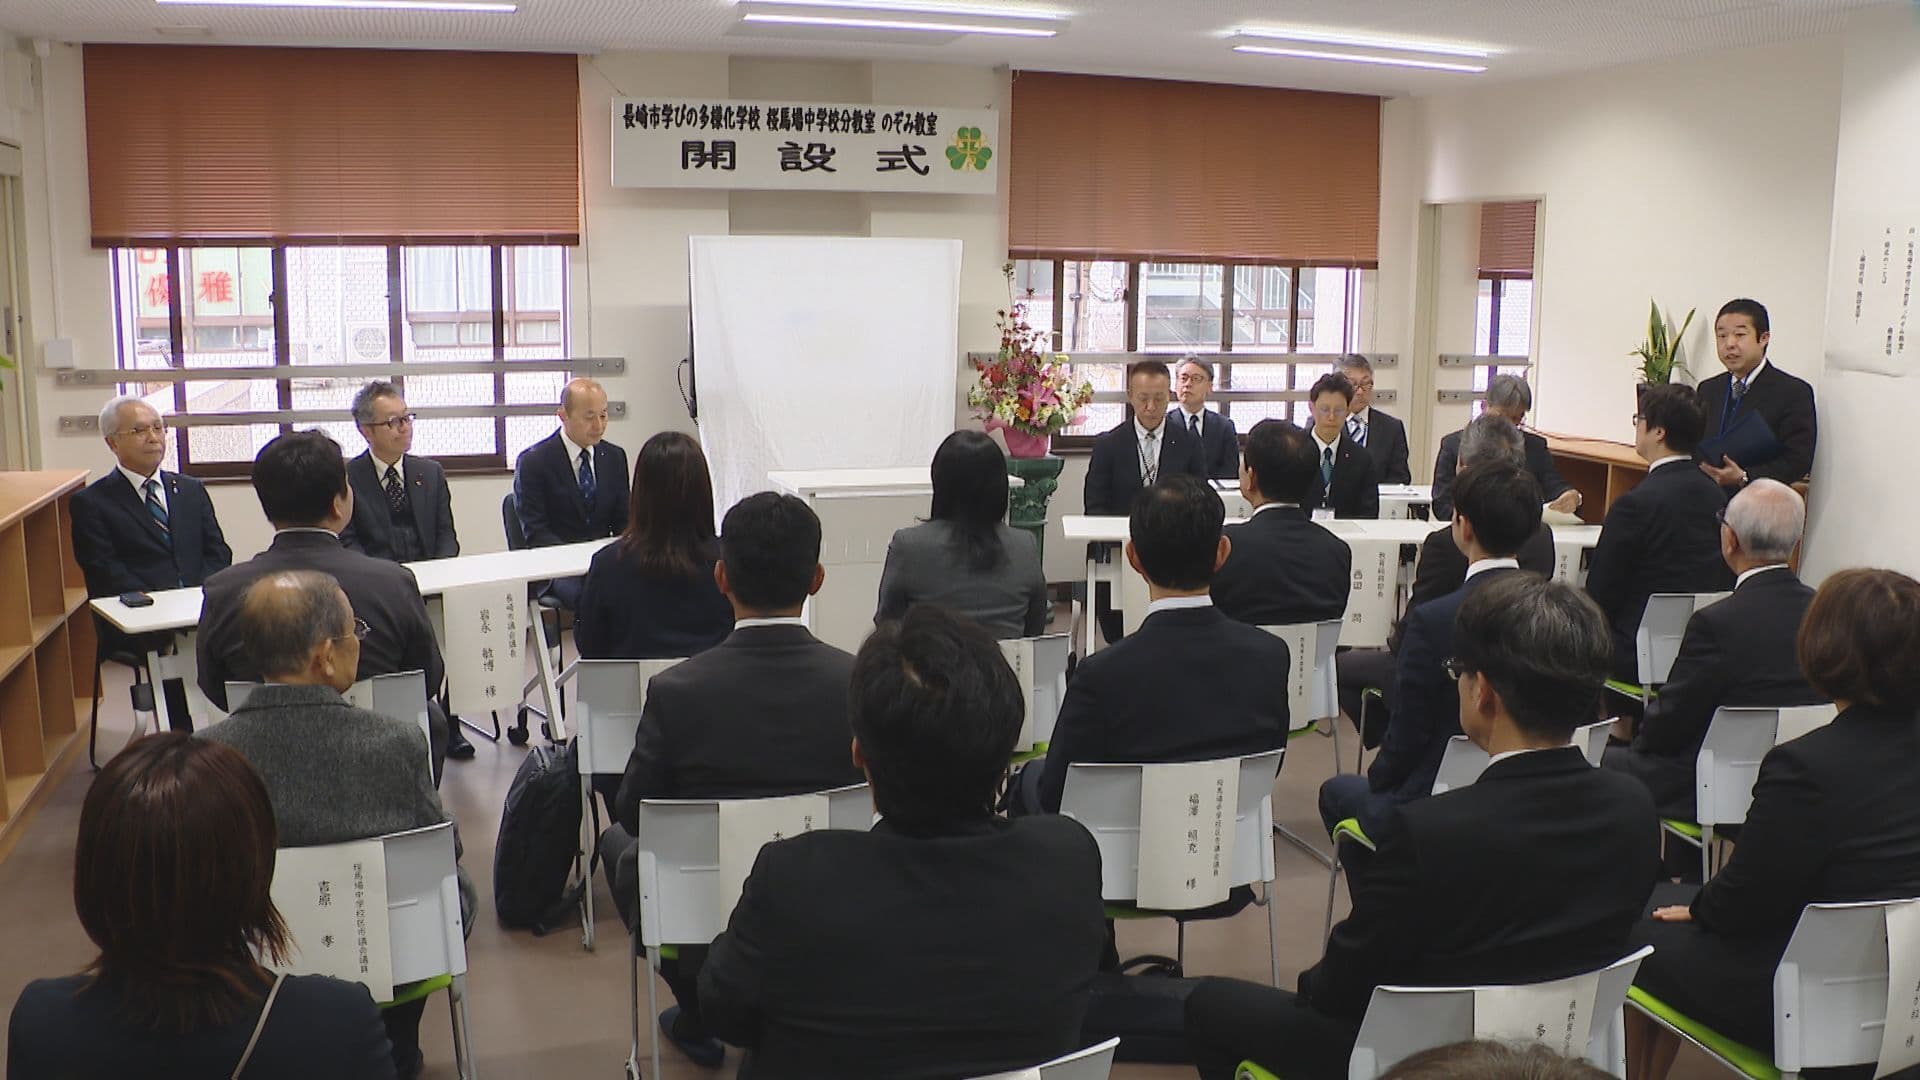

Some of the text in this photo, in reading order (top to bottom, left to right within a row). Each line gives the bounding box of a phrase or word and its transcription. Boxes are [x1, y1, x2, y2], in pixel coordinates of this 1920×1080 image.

[623, 103, 938, 136] 長崎市学びの多様化学校 桜馬場中学校分教室 のぞみ教室
